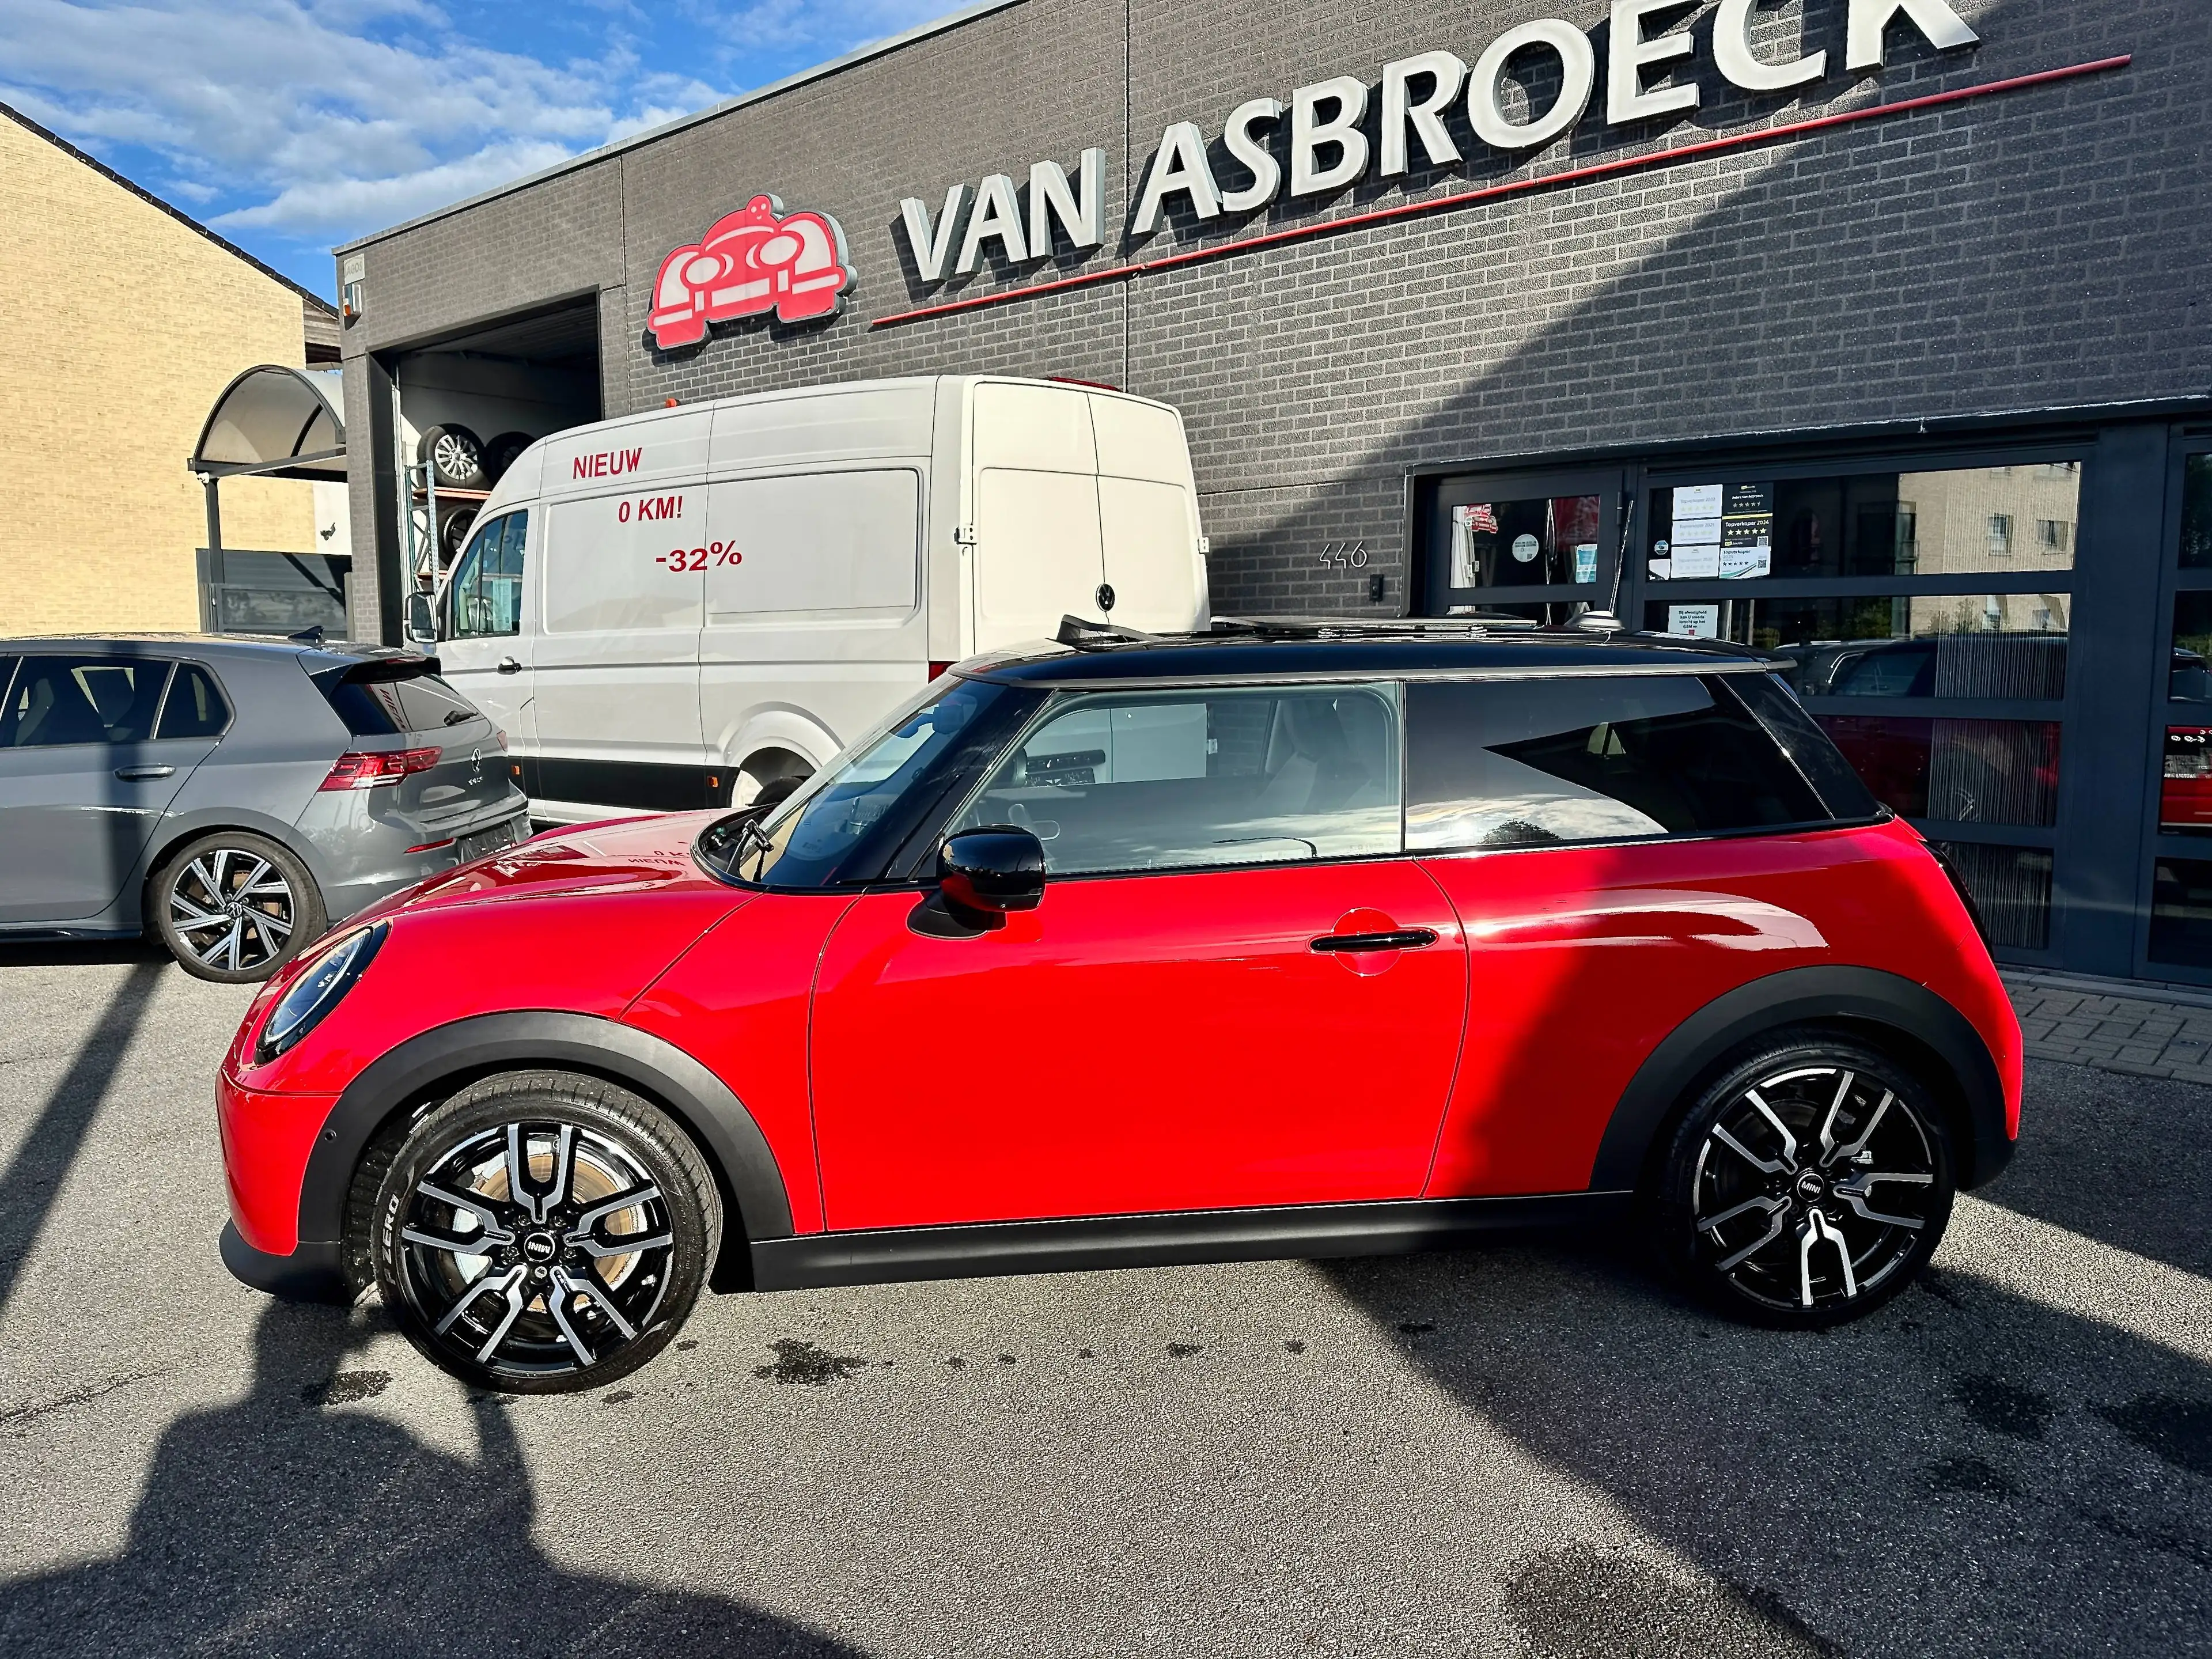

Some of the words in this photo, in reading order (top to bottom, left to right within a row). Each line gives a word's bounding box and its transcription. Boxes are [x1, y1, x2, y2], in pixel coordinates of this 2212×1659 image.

[900, 147, 1105, 282] VAN
[573, 447, 642, 479] NIEUW
[619, 501, 630, 522] 0
[638, 496, 683, 521] KM!
[656, 540, 743, 572] -32%
[1319, 541, 1367, 570] 446
[1801, 1181, 1821, 1194] MINI
[382, 1194, 399, 1264] ZERO
[528, 1241, 551, 1254] MINI
